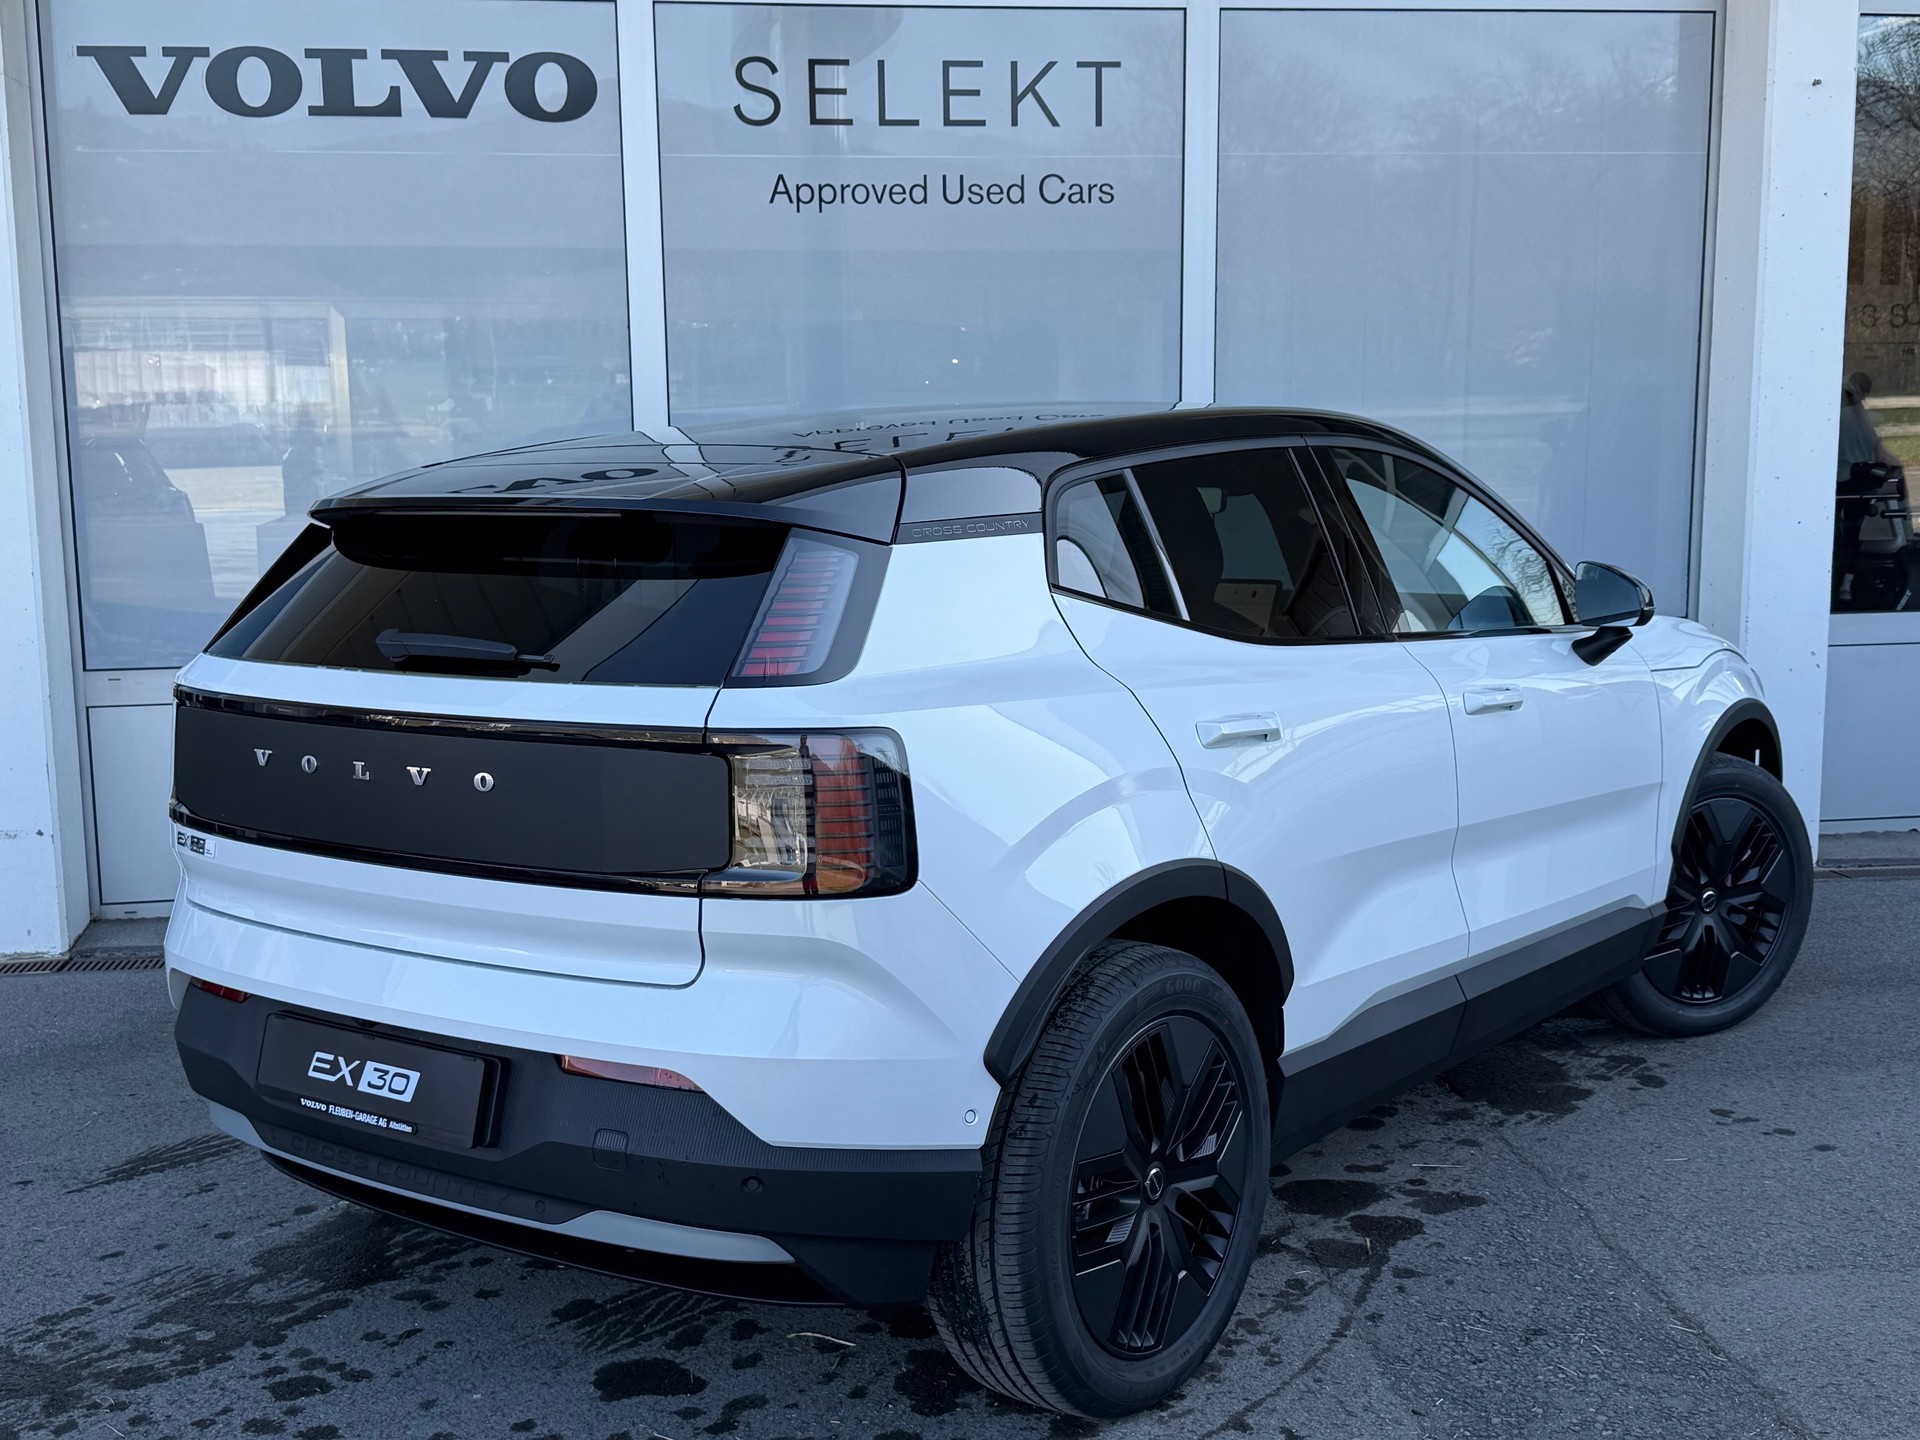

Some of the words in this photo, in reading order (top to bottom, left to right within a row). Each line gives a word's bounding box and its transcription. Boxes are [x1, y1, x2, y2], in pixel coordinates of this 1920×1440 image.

[76, 45, 598, 123] VOLVO
[733, 56, 1122, 127] SELEKT
[769, 174, 928, 213] Approved
[941, 174, 1025, 205] Used
[1038, 174, 1115, 205] Cars
[912, 525, 963, 538] CROSS
[966, 519, 1030, 533] COUNTRY
[254, 748, 495, 792] VOLVO
[300, 1098, 327, 1112] VOLVO
[378, 1117, 388, 1128] AG
